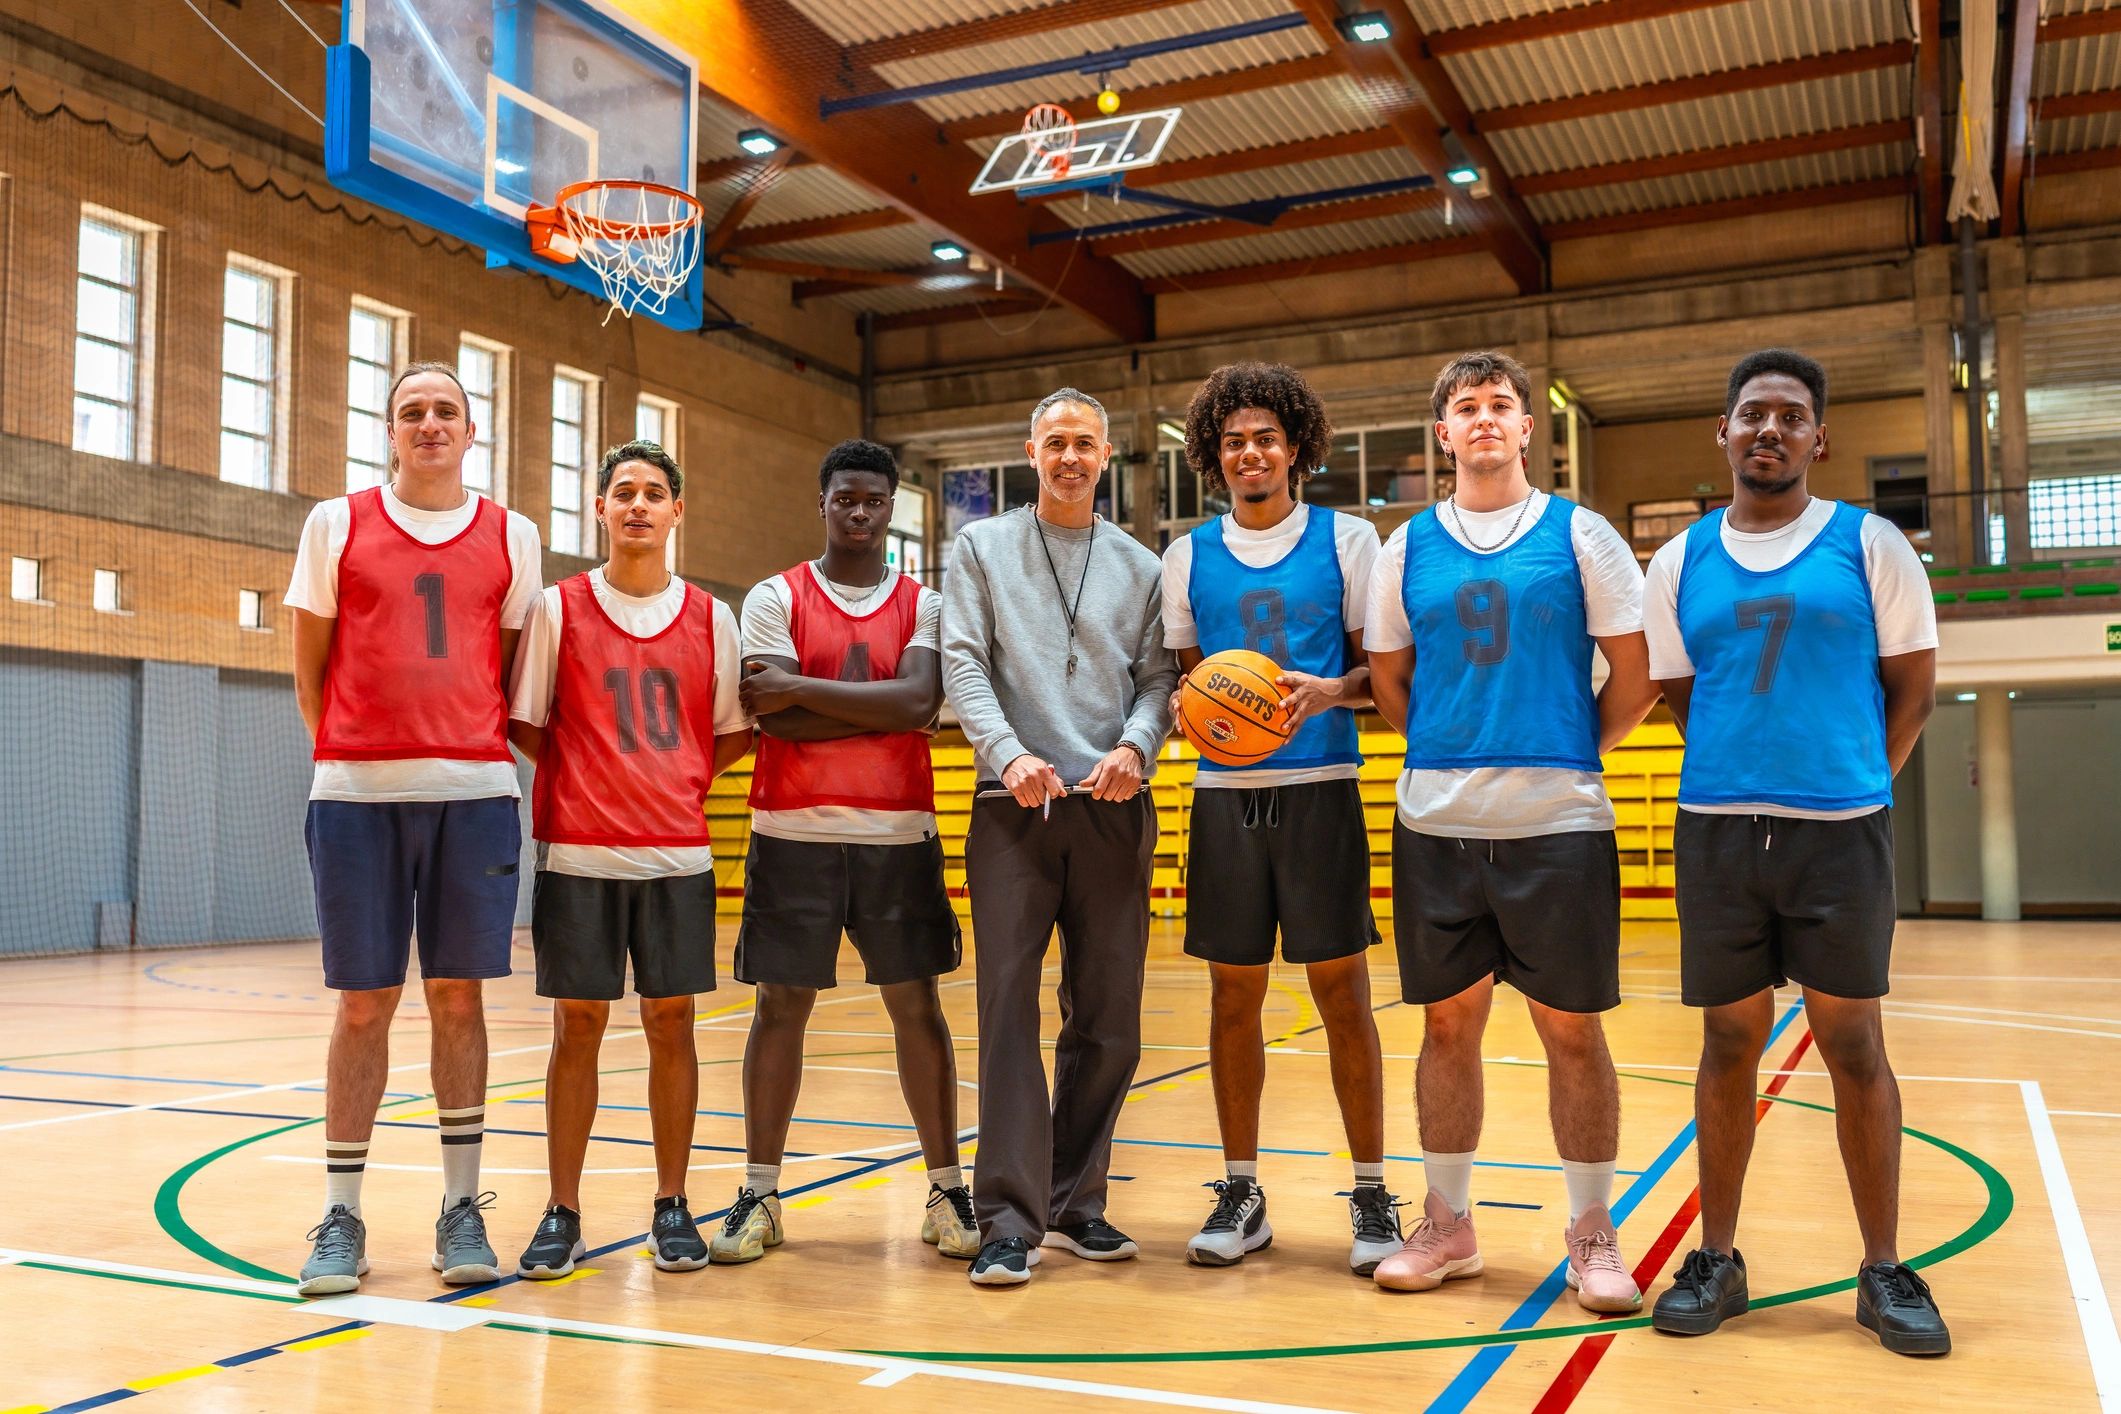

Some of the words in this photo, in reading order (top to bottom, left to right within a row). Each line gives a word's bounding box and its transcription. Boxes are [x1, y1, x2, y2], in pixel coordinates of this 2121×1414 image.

[414, 573, 448, 659] 1
[1240, 588, 1289, 667] 8
[1455, 578, 1512, 667] 9
[1734, 592, 1796, 696] 7
[603, 667, 682, 754] 10
[1206, 672, 1277, 722] SPORTS
